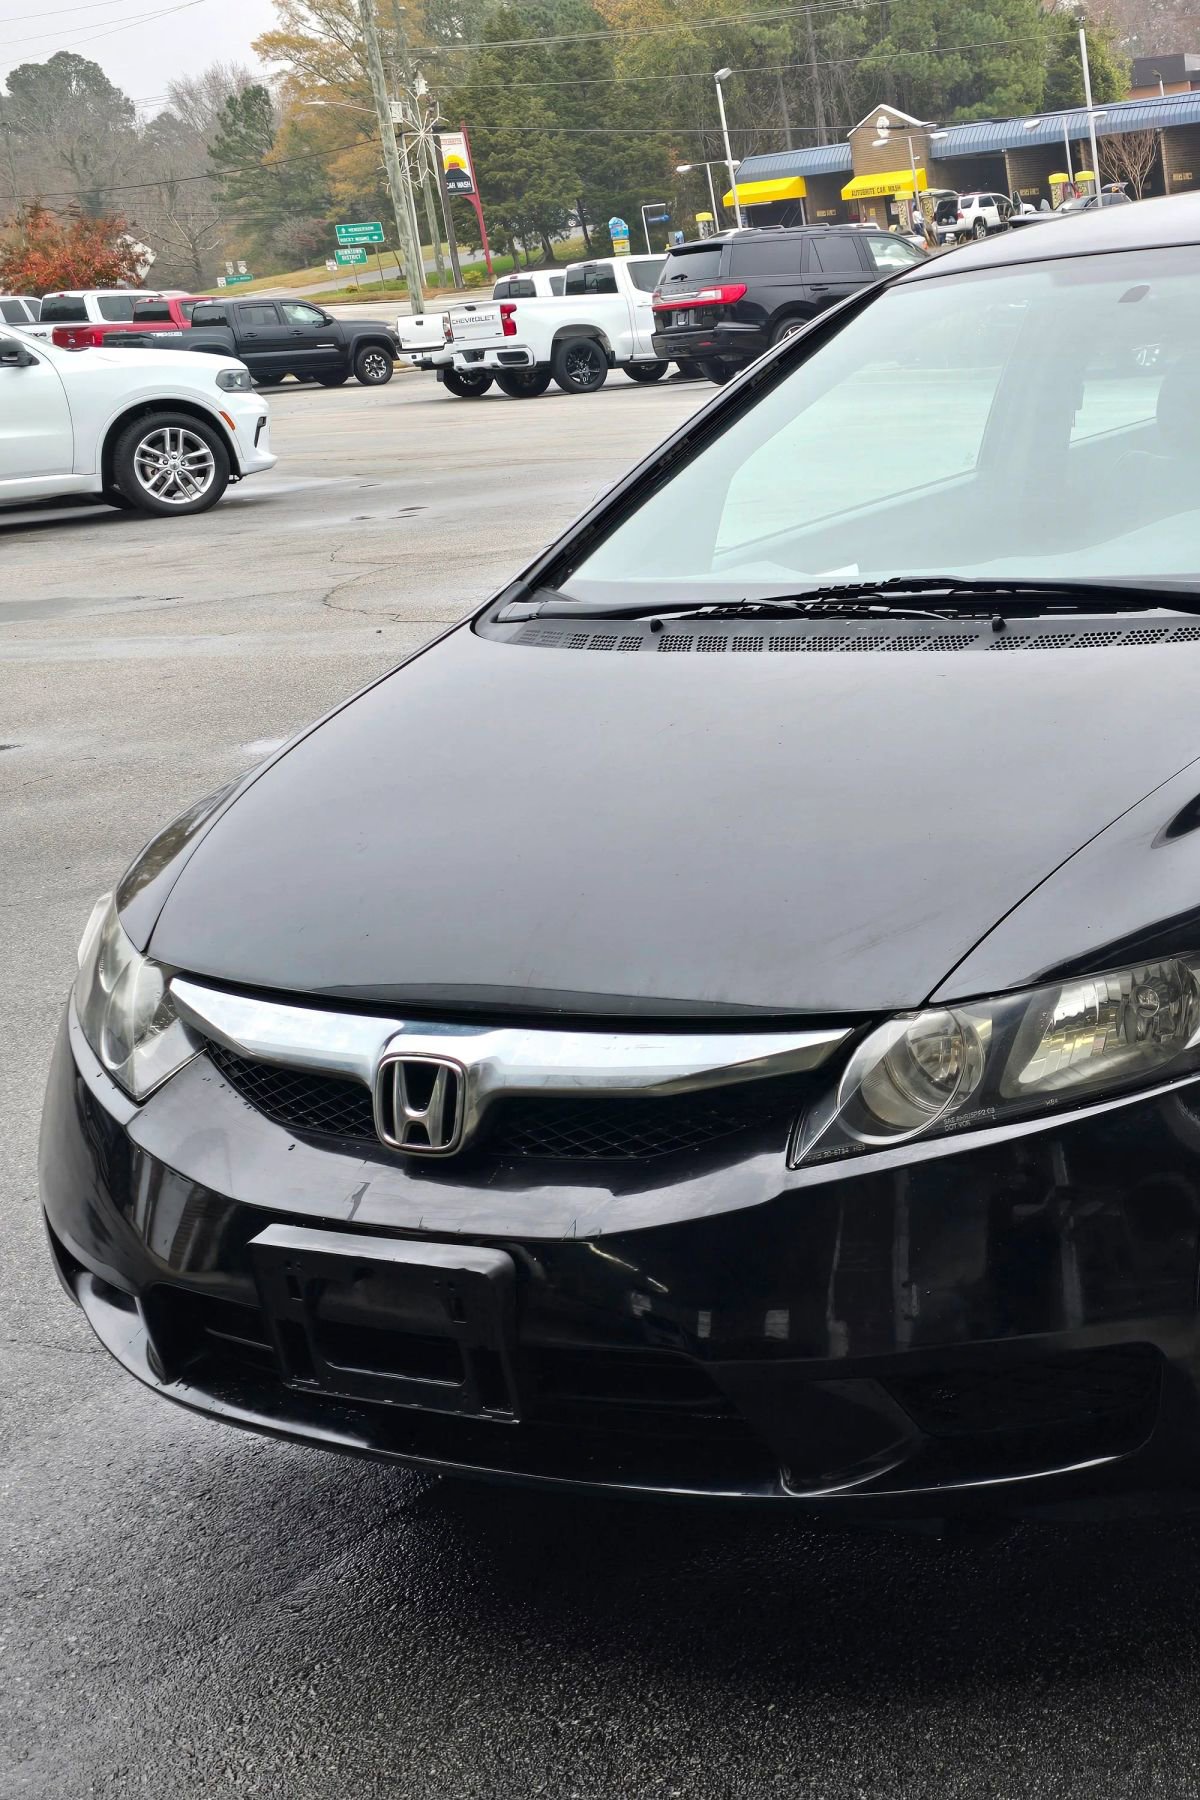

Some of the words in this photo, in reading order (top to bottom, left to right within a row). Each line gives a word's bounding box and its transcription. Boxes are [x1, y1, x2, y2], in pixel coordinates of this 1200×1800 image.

[456, 181, 471, 189] WASH
[877, 185, 886, 194] CAR
[451, 314, 496, 325] CHEVROLET
